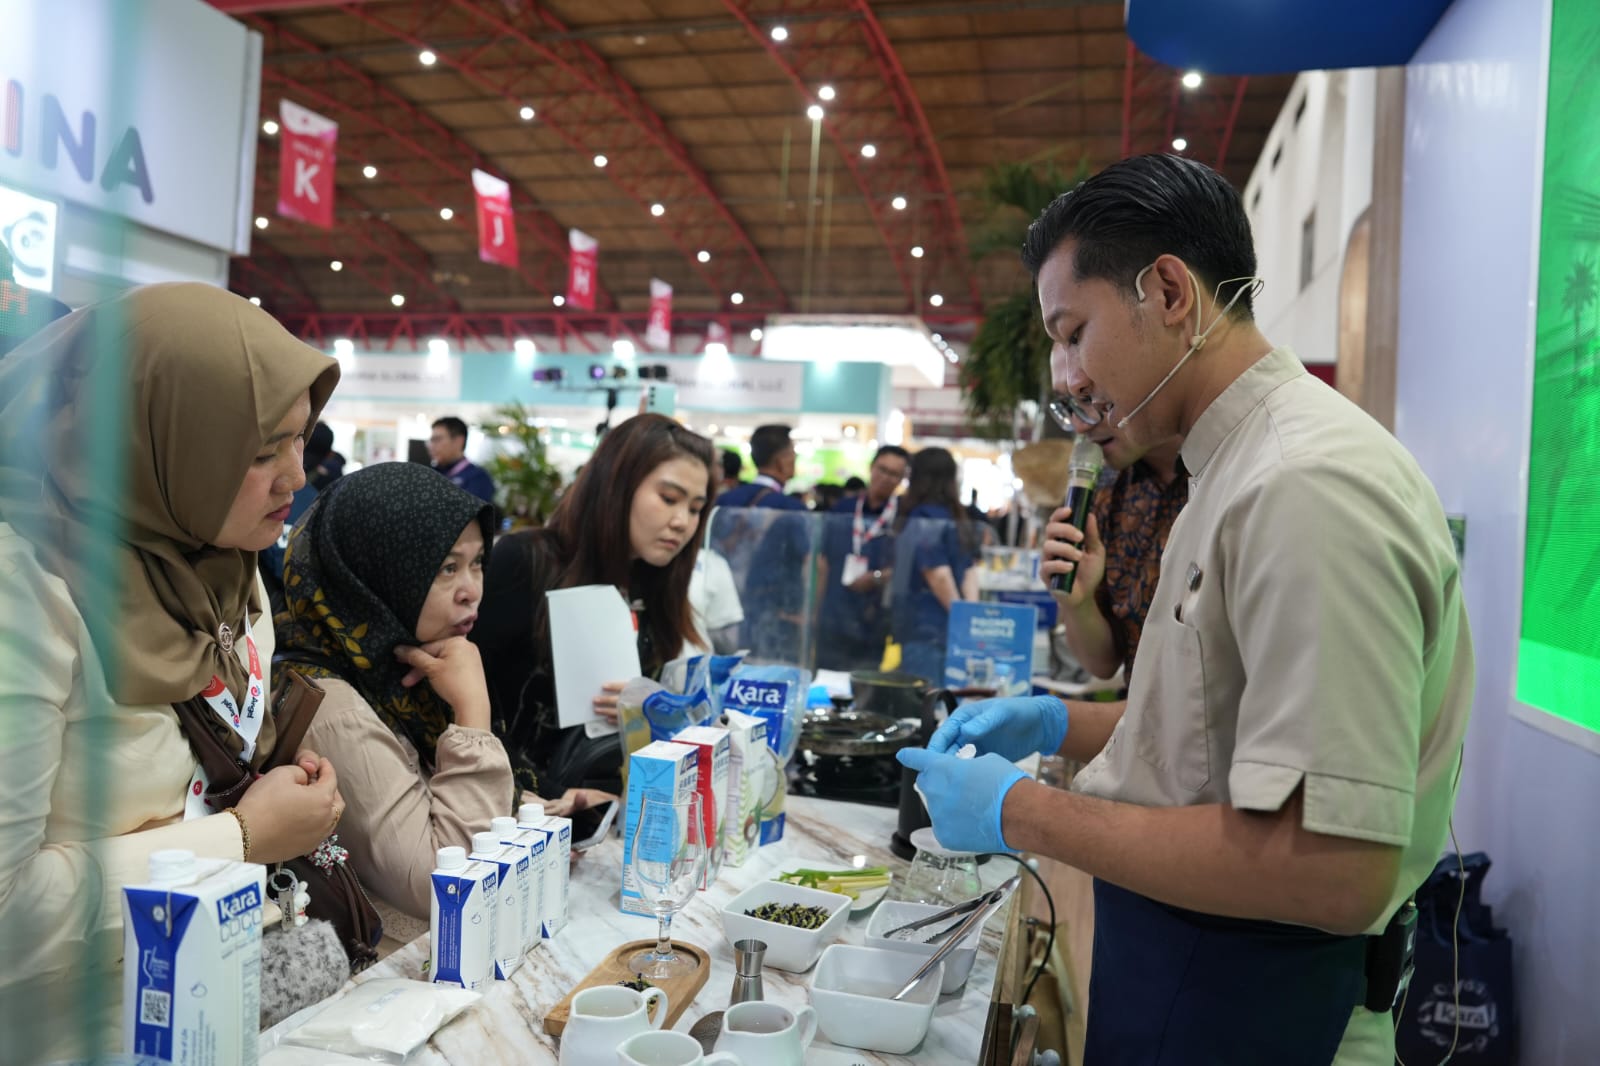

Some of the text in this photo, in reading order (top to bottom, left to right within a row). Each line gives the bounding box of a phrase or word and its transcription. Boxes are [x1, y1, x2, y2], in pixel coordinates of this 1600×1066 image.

[294, 158, 320, 204] K
[492, 215, 505, 247] J
[247, 696, 259, 719] Angel
[730, 681, 782, 706] kara
[219, 889, 257, 921] kara
[220, 907, 262, 943] COCO
